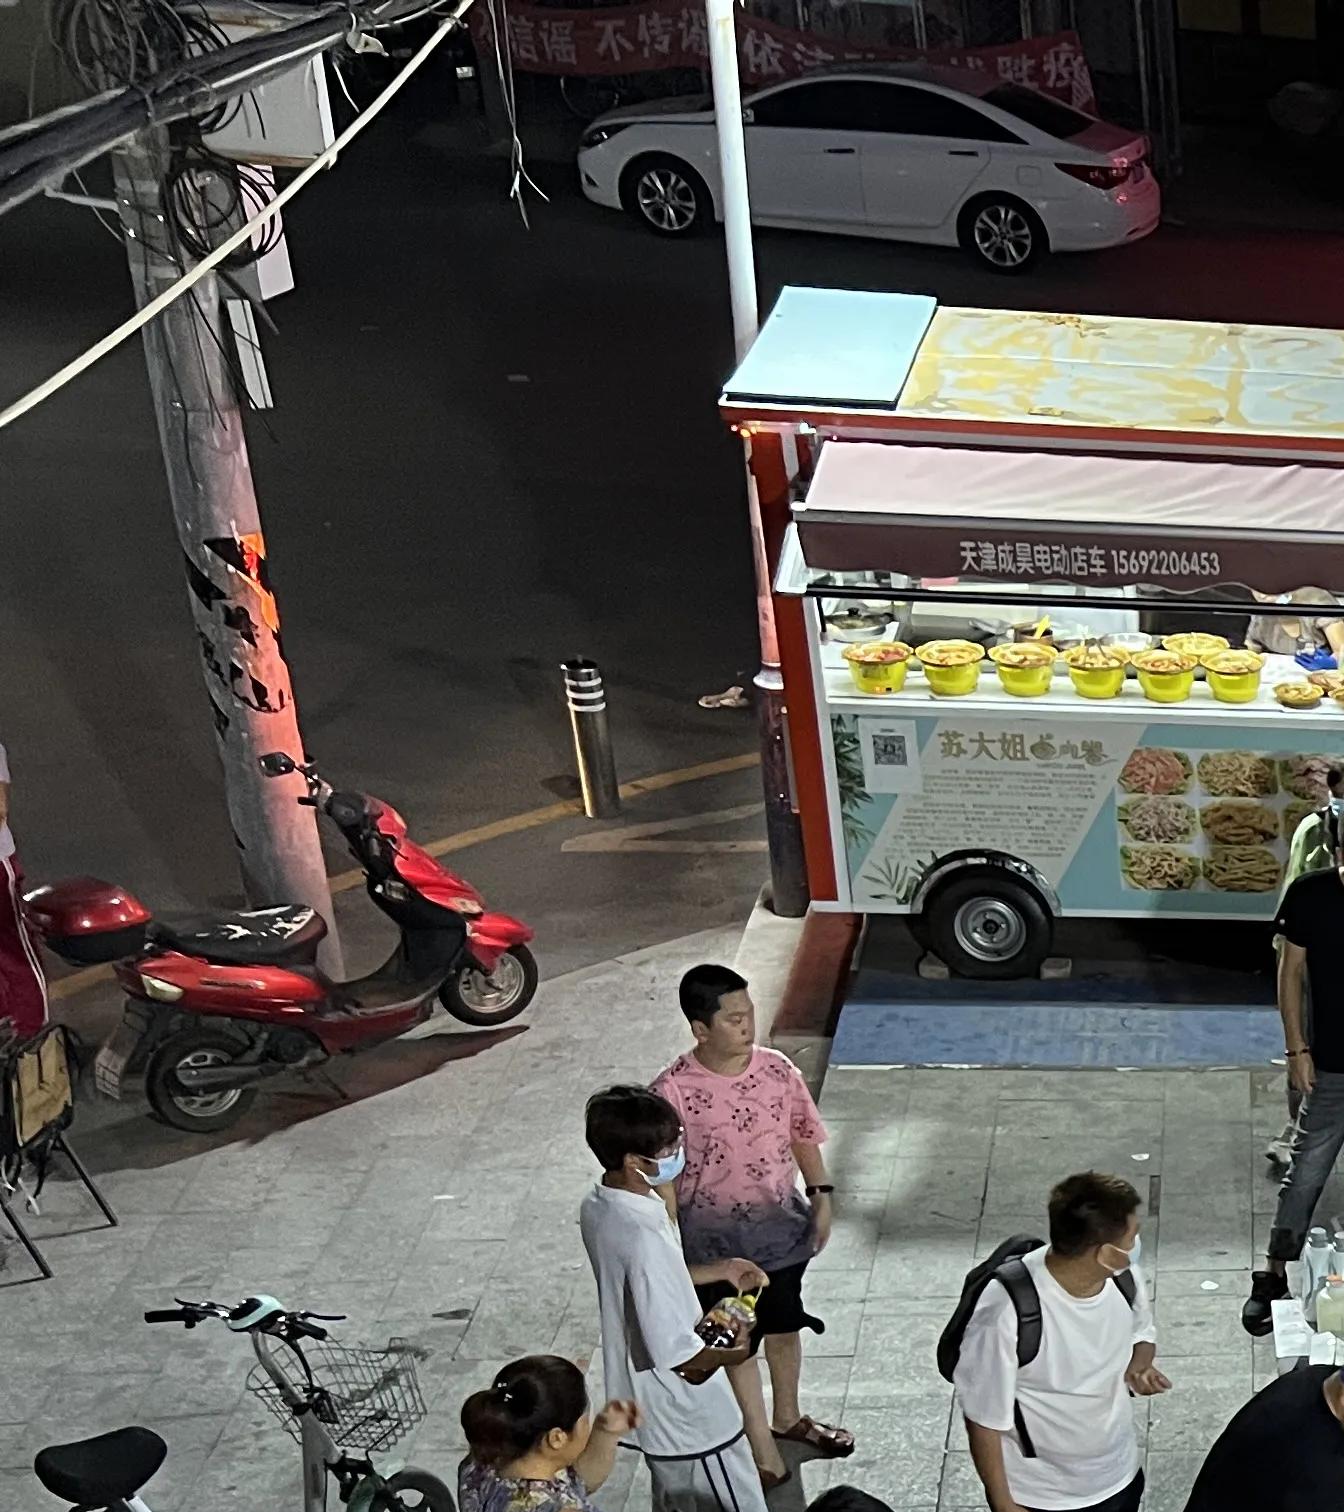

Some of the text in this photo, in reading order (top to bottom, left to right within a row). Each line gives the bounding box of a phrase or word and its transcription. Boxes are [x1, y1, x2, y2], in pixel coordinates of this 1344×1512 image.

[959, 541, 1221, 576] 天津成昊电动店车 15692206453
